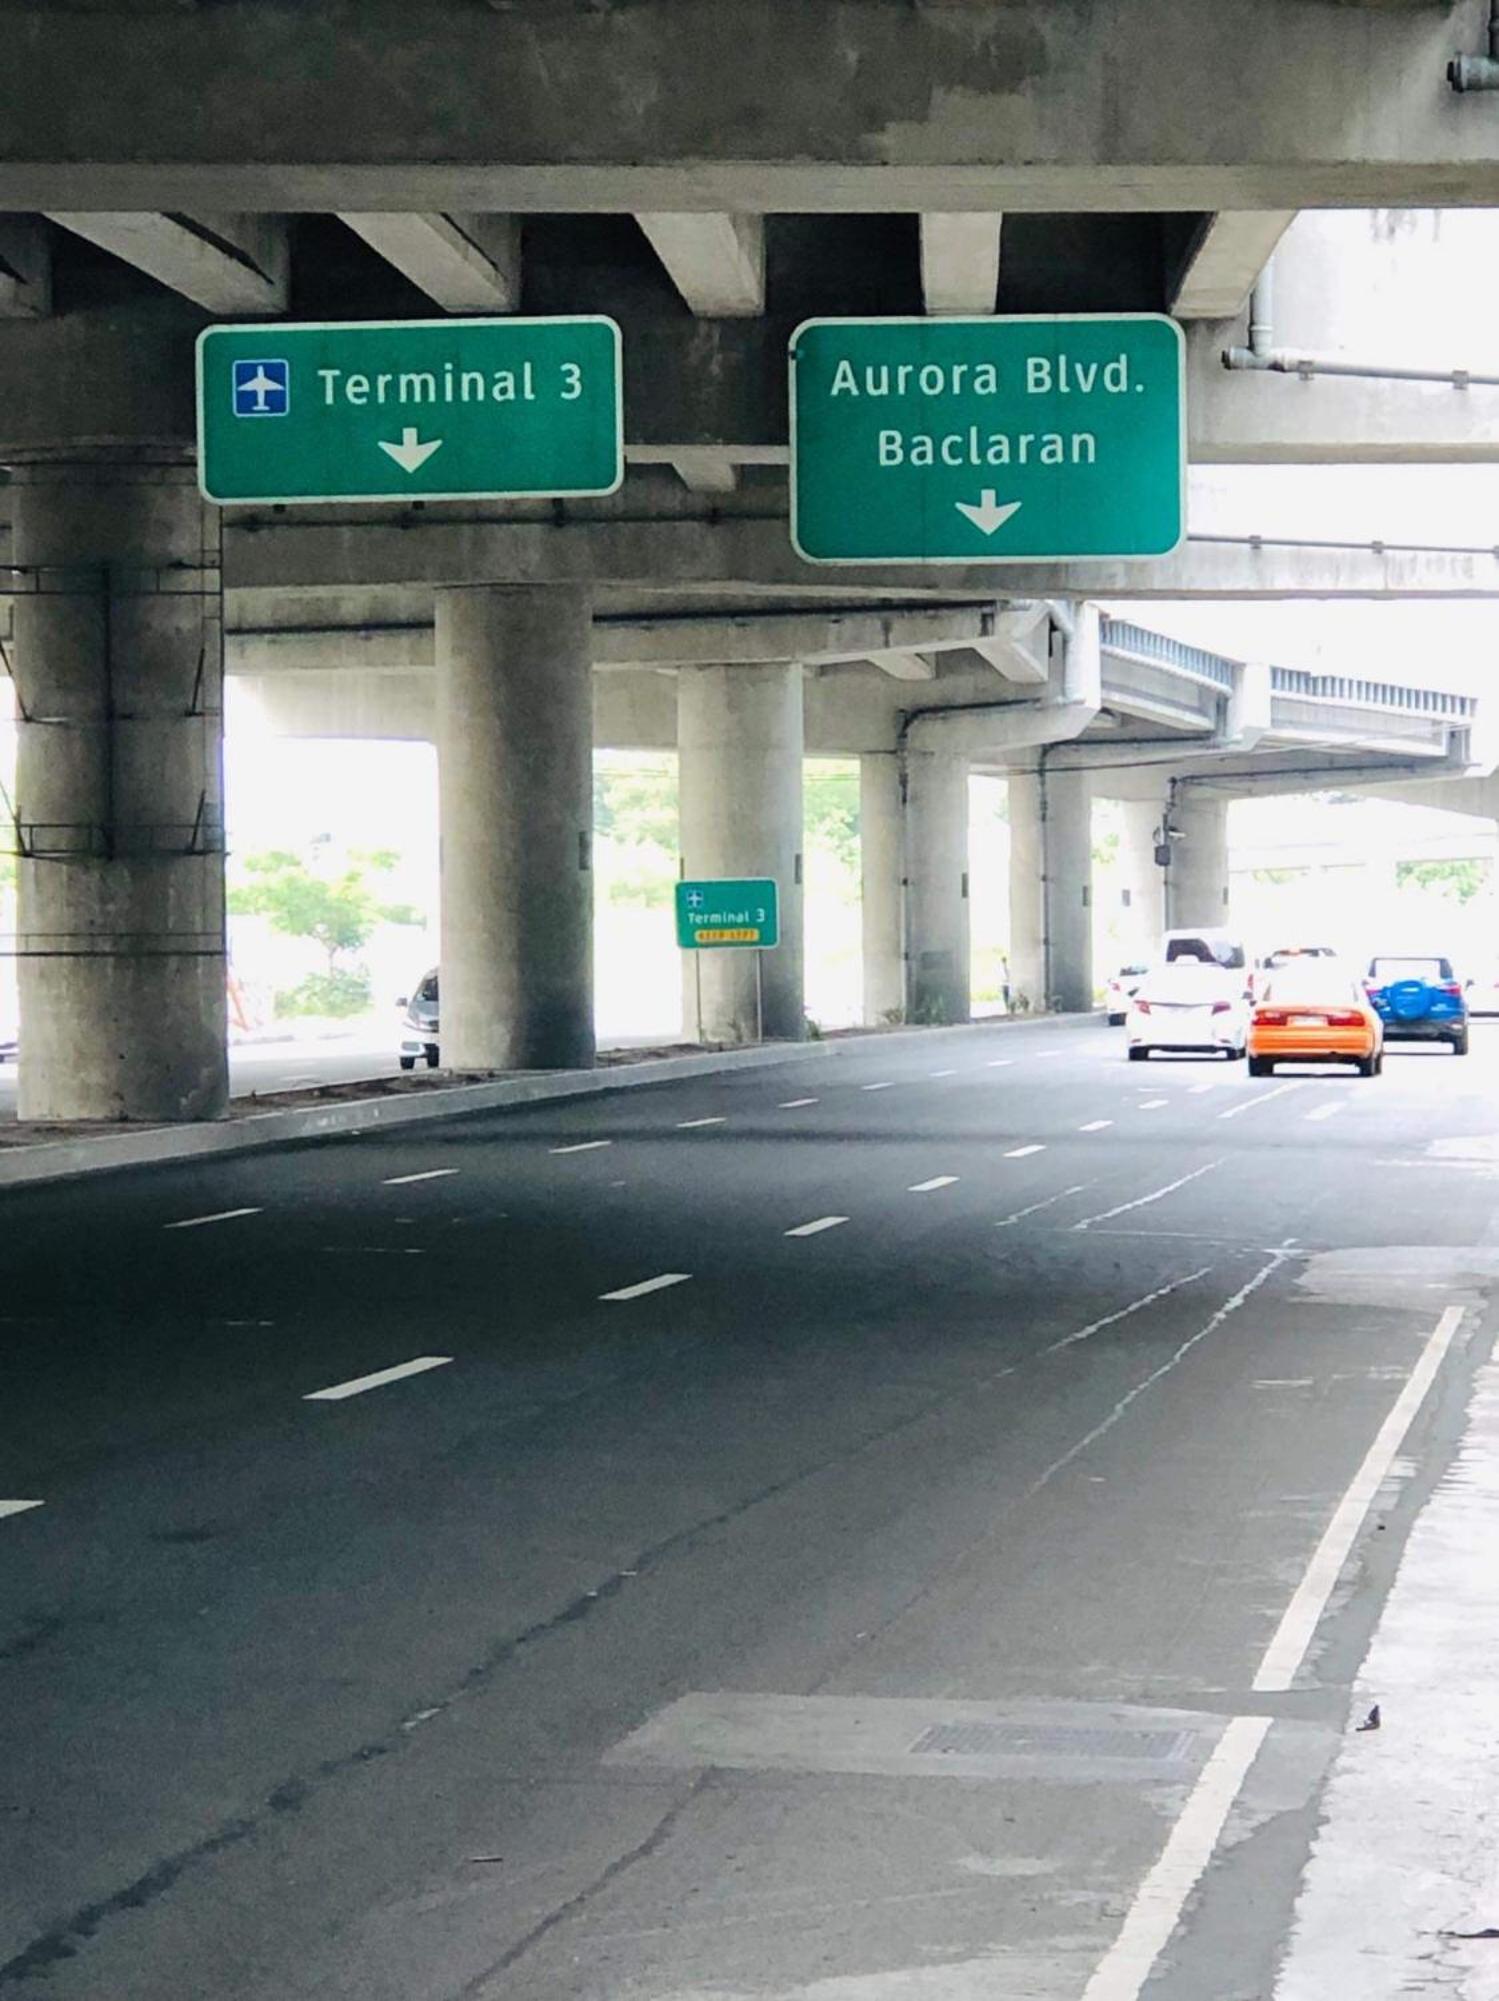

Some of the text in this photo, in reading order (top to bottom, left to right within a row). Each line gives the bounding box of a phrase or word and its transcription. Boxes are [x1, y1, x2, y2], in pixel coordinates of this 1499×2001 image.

[317, 361, 584, 406] Terminal 3
[830, 353, 1146, 396] Aurora Blvd.
[878, 426, 1097, 466] Baclaran
[687, 908, 765, 924] Terminal 3
